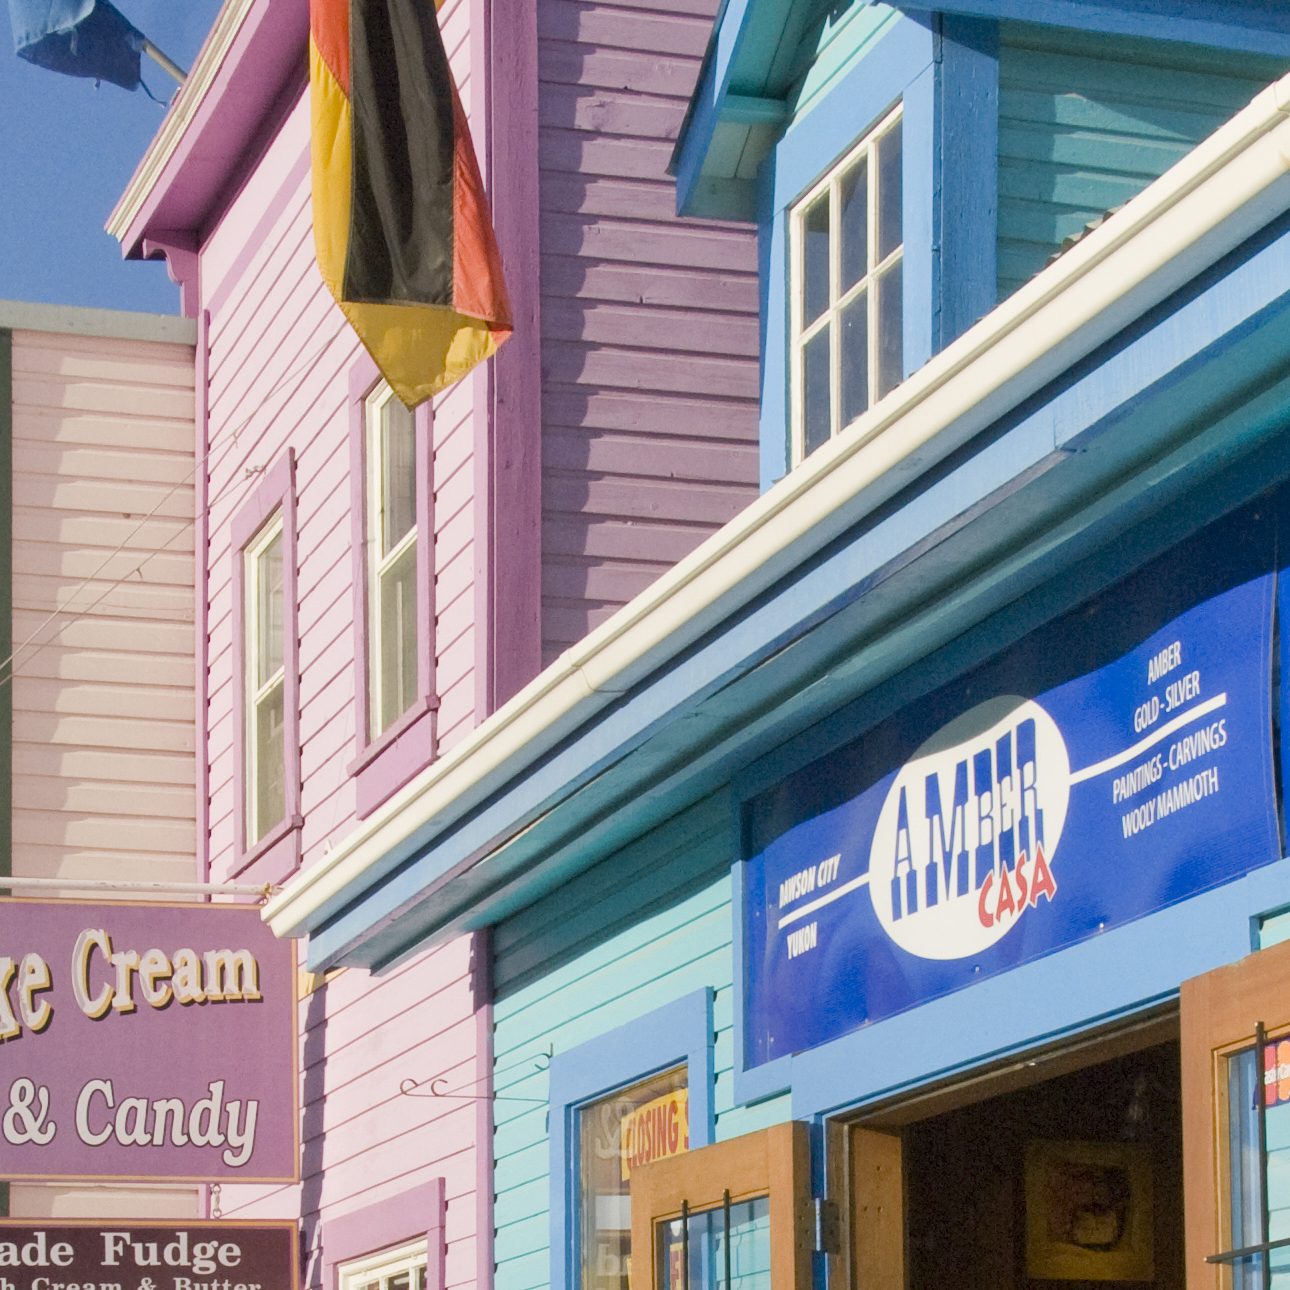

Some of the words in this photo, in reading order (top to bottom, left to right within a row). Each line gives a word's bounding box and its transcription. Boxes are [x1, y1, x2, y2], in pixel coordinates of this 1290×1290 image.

[1148, 640, 1182, 686] AMBER
[1134, 696, 1159, 733] GOLD
[1165, 670, 1200, 713] SILVER
[1113, 753, 1163, 804] PAINTINGS
[1169, 718, 1227, 771] CARVINGS
[891, 717, 1045, 923] AMBER
[1122, 798, 1156, 839] WOOLY
[1157, 766, 1219, 820] MAMMOTH
[779, 865, 817, 909] DAWSON
[817, 853, 842, 888] CITY
[977, 840, 1058, 929] CASA
[72, 927, 265, 1020] Cream
[787, 921, 817, 960] YUKON
[2, 1077, 56, 1148] &
[75, 1078, 259, 1167] Candy
[626, 1100, 679, 1169] CLOSING
[100, 1231, 242, 1274] Fudge
